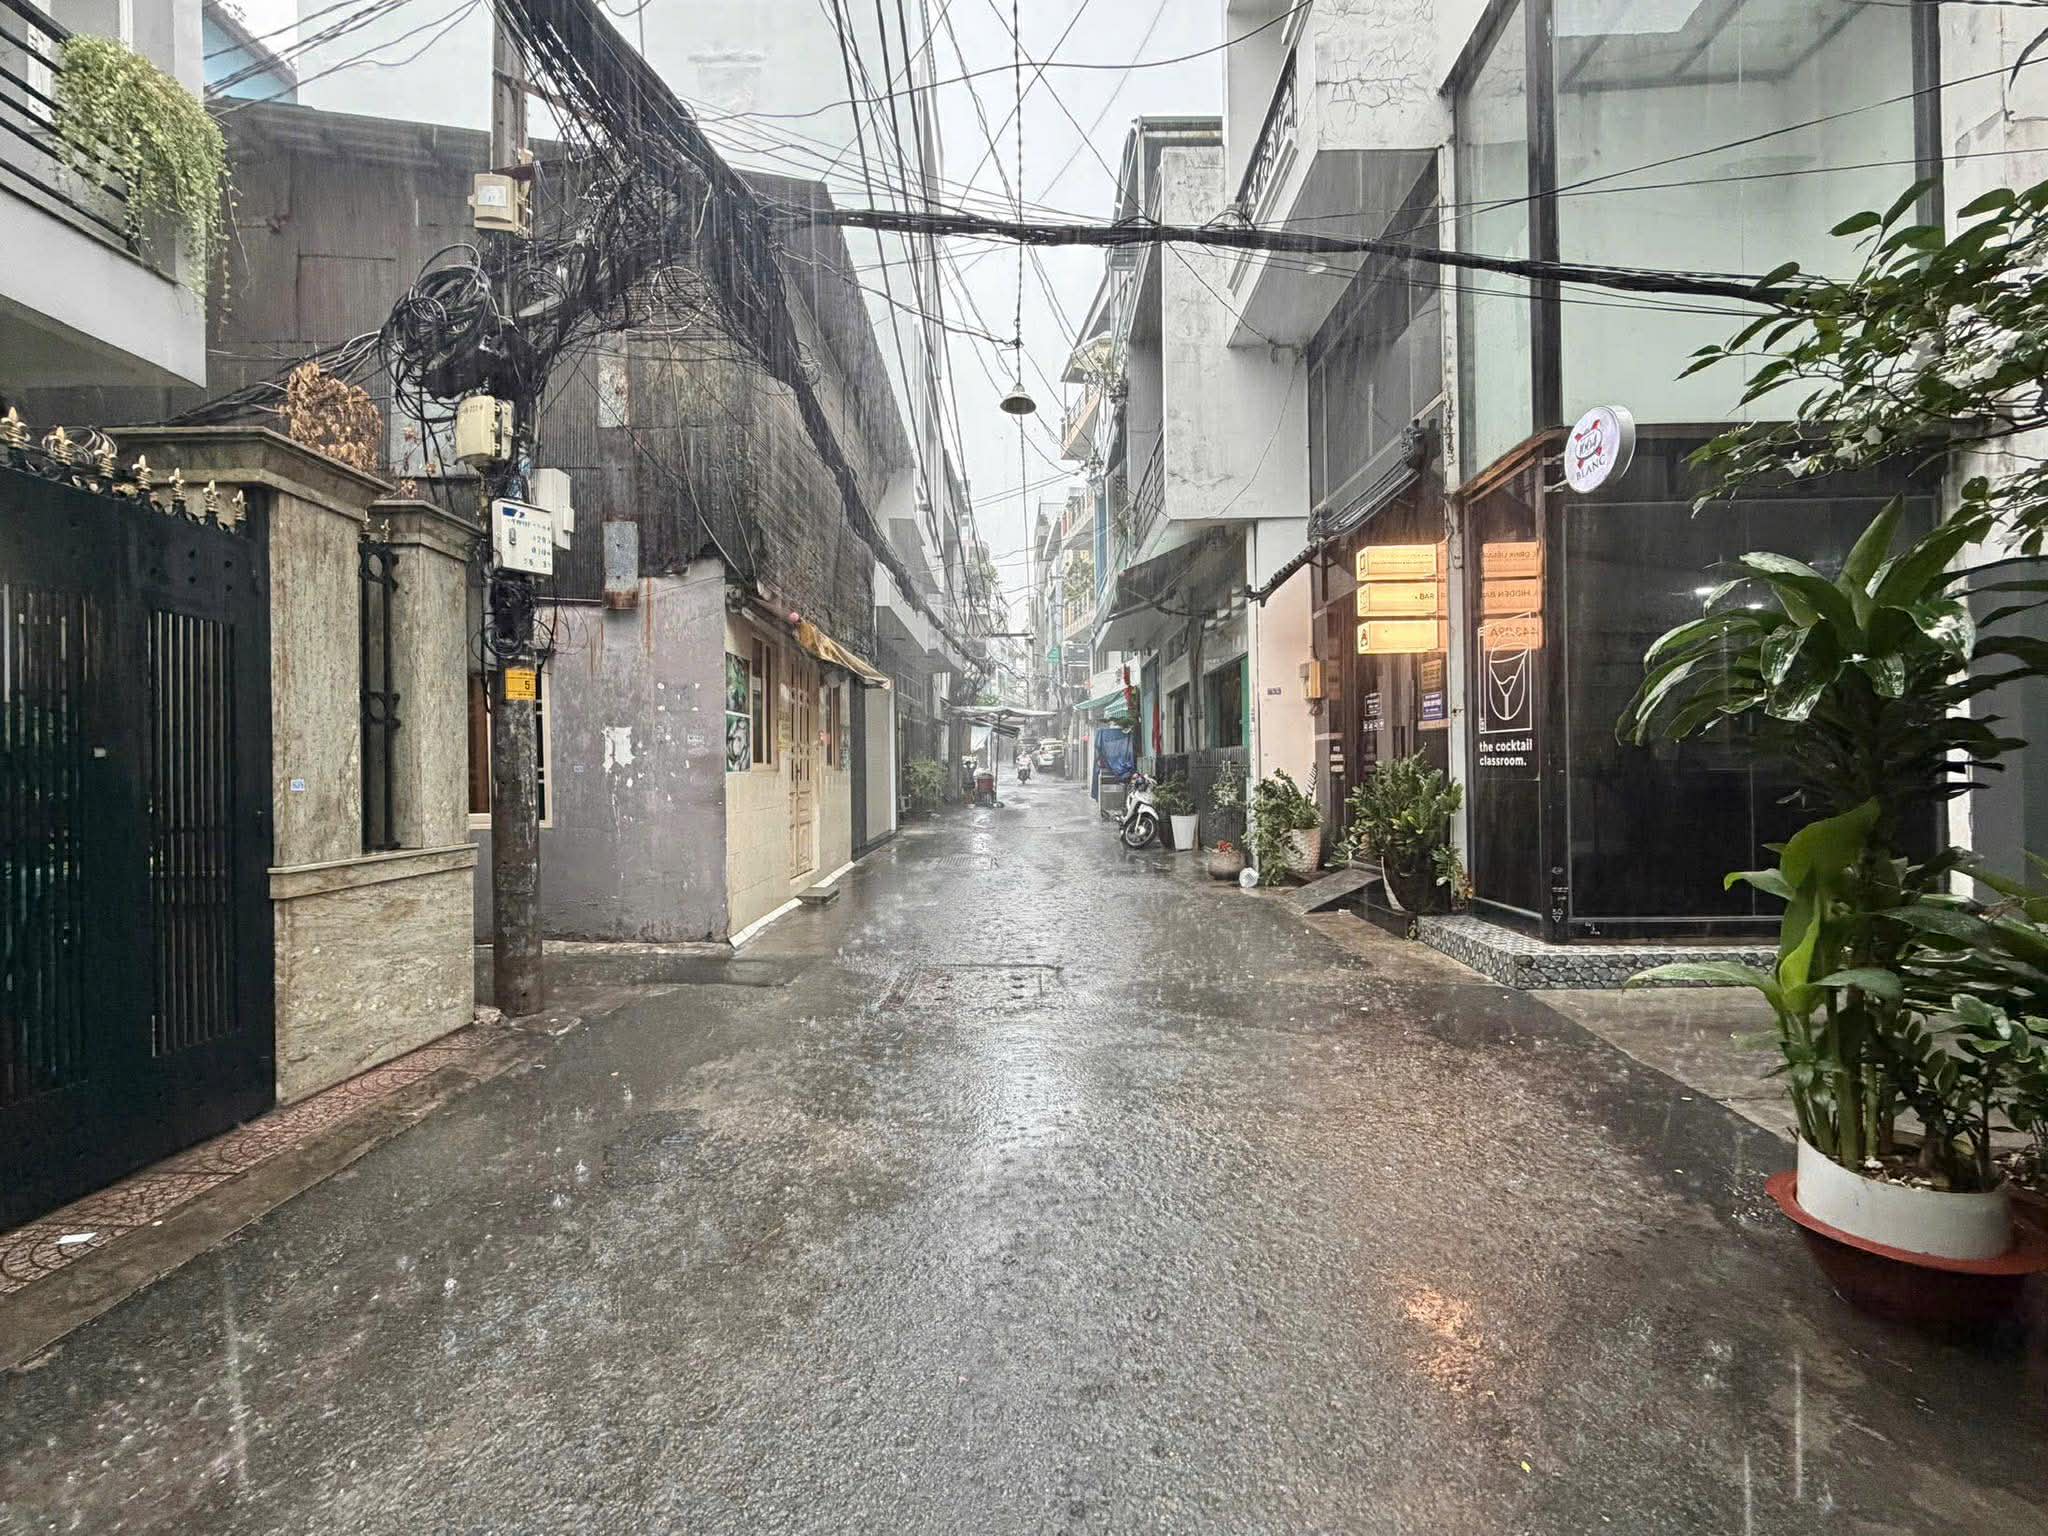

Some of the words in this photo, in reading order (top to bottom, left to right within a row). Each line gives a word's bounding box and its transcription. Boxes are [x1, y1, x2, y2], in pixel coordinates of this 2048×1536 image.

[1576, 454, 1606, 480] BLANC
[524, 680, 531, 690] 5
[1479, 740, 1493, 752] the
[1495, 738, 1533, 752] cocktail
[1479, 755, 1527, 766] classroom.
